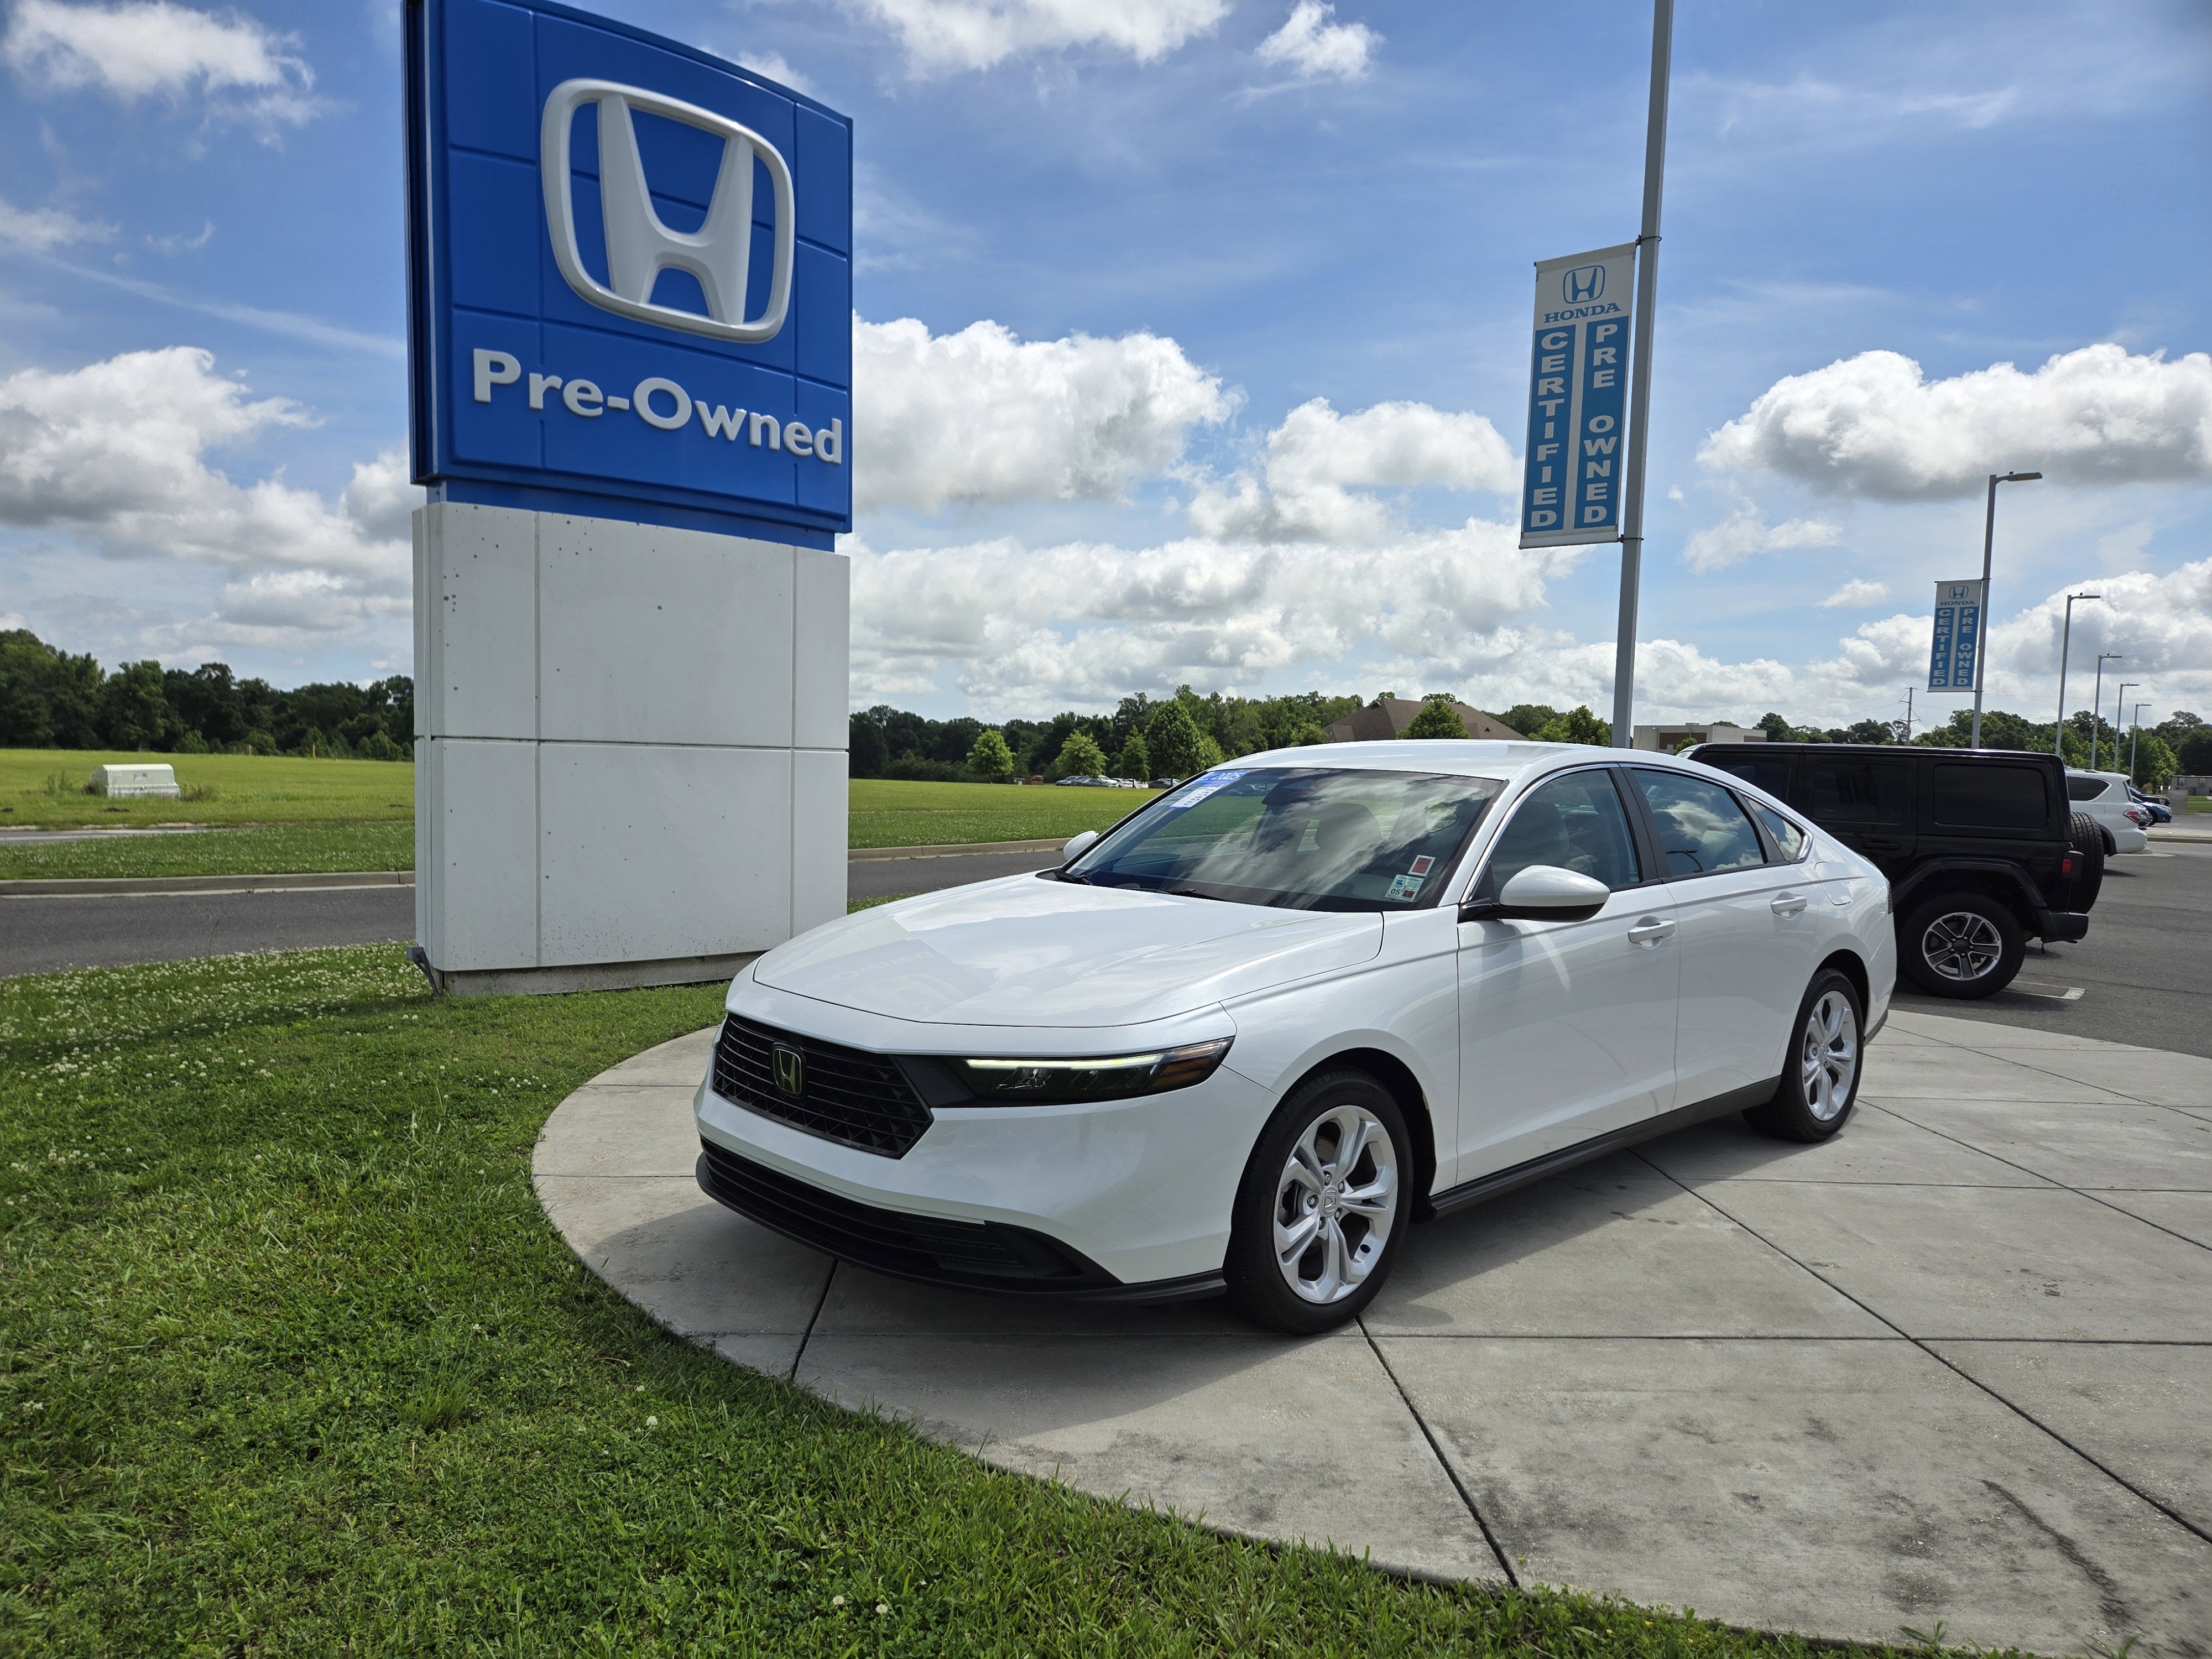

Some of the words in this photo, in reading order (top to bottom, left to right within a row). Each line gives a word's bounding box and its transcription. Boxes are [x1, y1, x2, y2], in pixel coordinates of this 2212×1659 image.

[1543, 302, 1621, 324] HONDA
[1593, 323, 1619, 388] PRE
[473, 348, 842, 465] Pre-Owned
[1530, 331, 1569, 528] CERTIFIED
[1583, 414, 1617, 524] OWNED
[1932, 609, 1952, 685] CERTIFIED
[1962, 608, 1974, 633] PRE
[1957, 643, 1973, 685] OWNED
[1211, 772, 1245, 780] 2025
